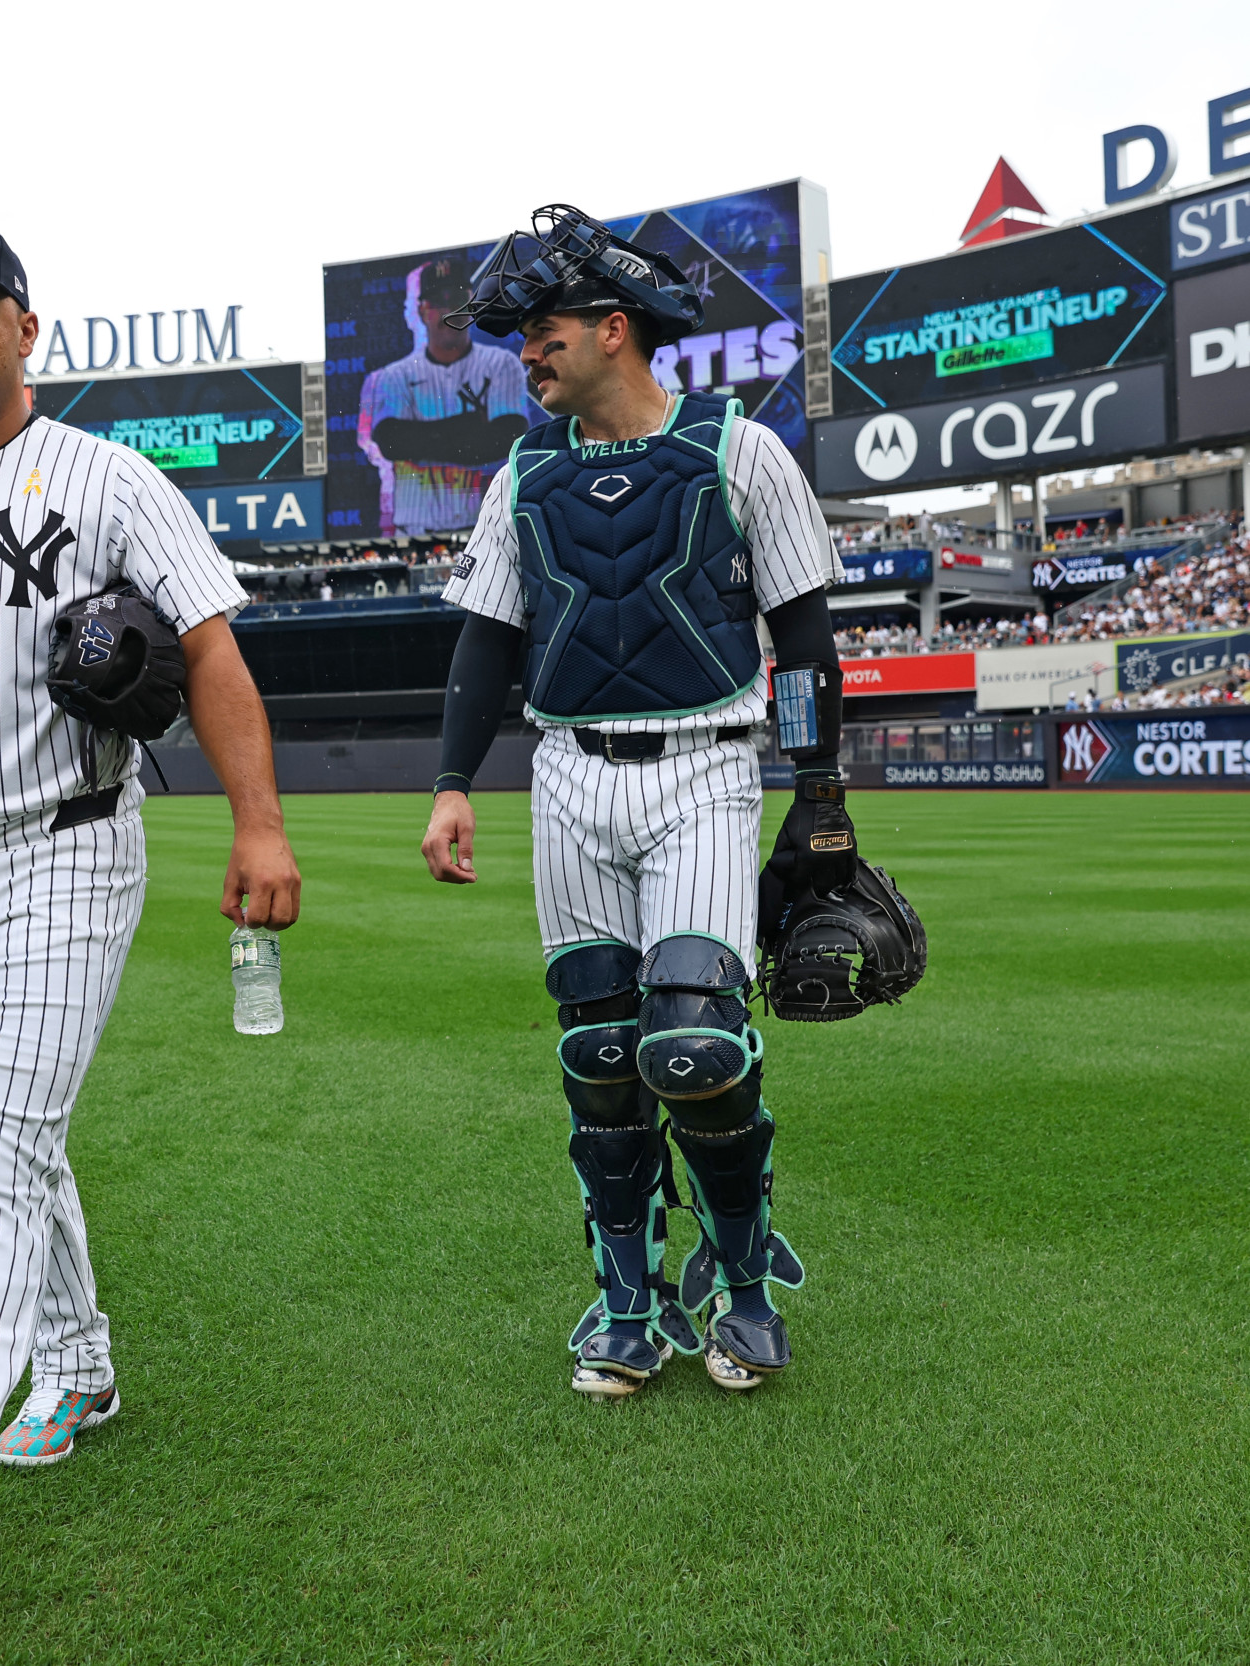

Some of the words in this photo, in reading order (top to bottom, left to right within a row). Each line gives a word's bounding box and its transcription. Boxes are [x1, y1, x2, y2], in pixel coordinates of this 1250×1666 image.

[1103, 87, 1250, 204] DE
[1177, 190, 1250, 259] ST
[38, 305, 243, 376] ADIUM
[864, 311, 1010, 364] STARTING
[1014, 286, 1128, 336] LINEUP
[650, 320, 799, 391] RTES
[1190, 321, 1250, 378] D
[90, 425, 185, 449] ARTING
[186, 418, 275, 447] LINEUP
[940, 381, 1119, 468] razr
[581, 437, 649, 460] WELLS
[206, 492, 307, 533] LTA
[872, 558, 895, 577] 65
[1065, 556, 1104, 568] NESTOR
[1065, 563, 1127, 585] CORTES
[78, 618, 114, 667] 44
[804, 671, 813, 698] CORTES
[842, 669, 883, 685] YOTA
[980, 673, 1007, 684] BANK
[1008, 671, 1024, 682] OF
[1025, 668, 1083, 681] AMERICA
[1137, 721, 1207, 741] NESTOR
[885, 765, 939, 783] StubHub
[941, 765, 991, 782] StubHub
[993, 764, 1045, 782] StubHub
